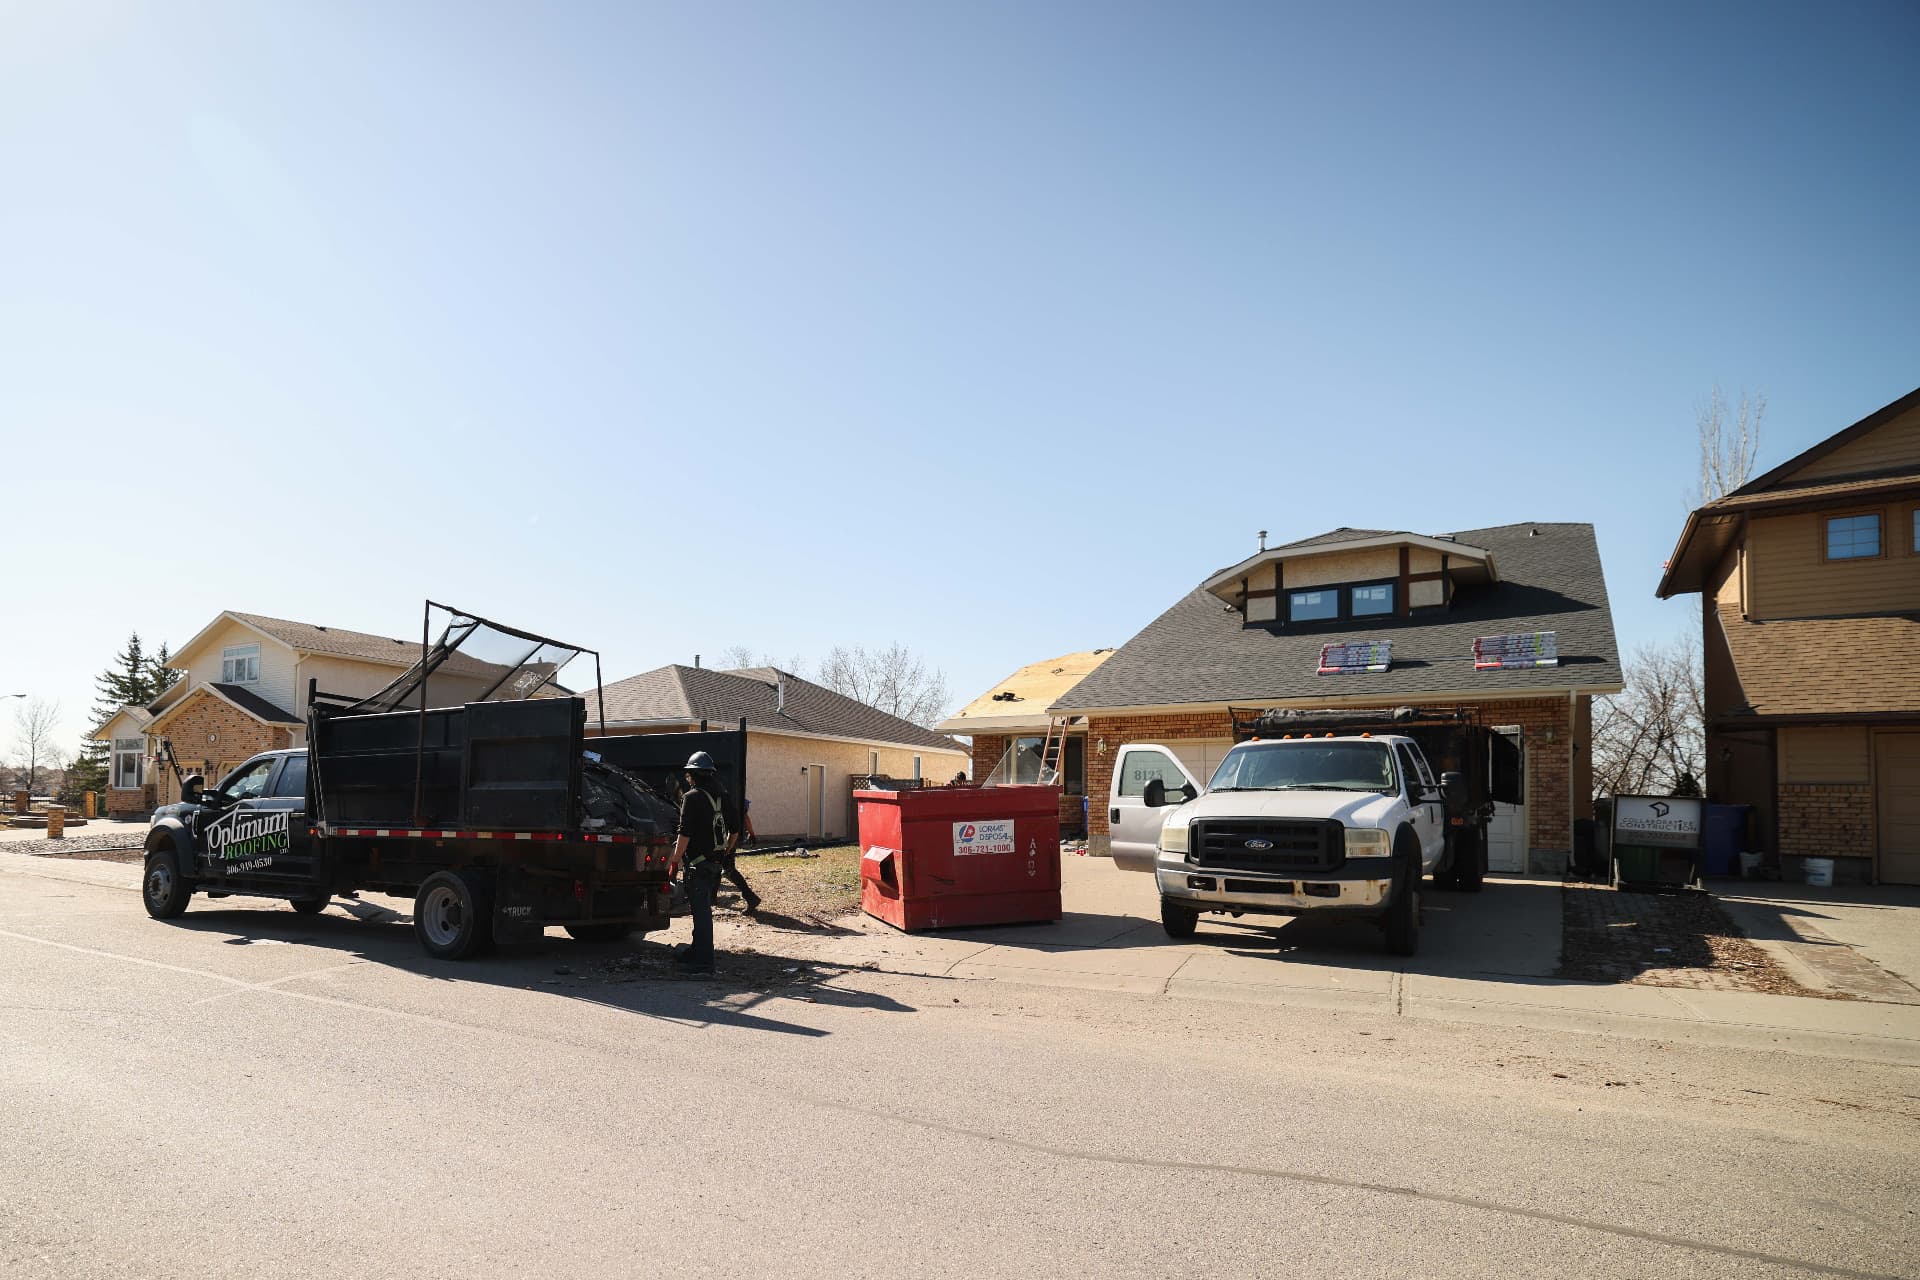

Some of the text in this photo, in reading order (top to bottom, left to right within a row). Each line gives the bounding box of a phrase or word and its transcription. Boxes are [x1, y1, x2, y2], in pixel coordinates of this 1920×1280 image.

[209, 805, 287, 859] Optimum
[1620, 822, 1697, 832] CONSTRUCTION
[225, 831, 287, 860] ROOFING
[507, 906, 532, 917] TRUCK
